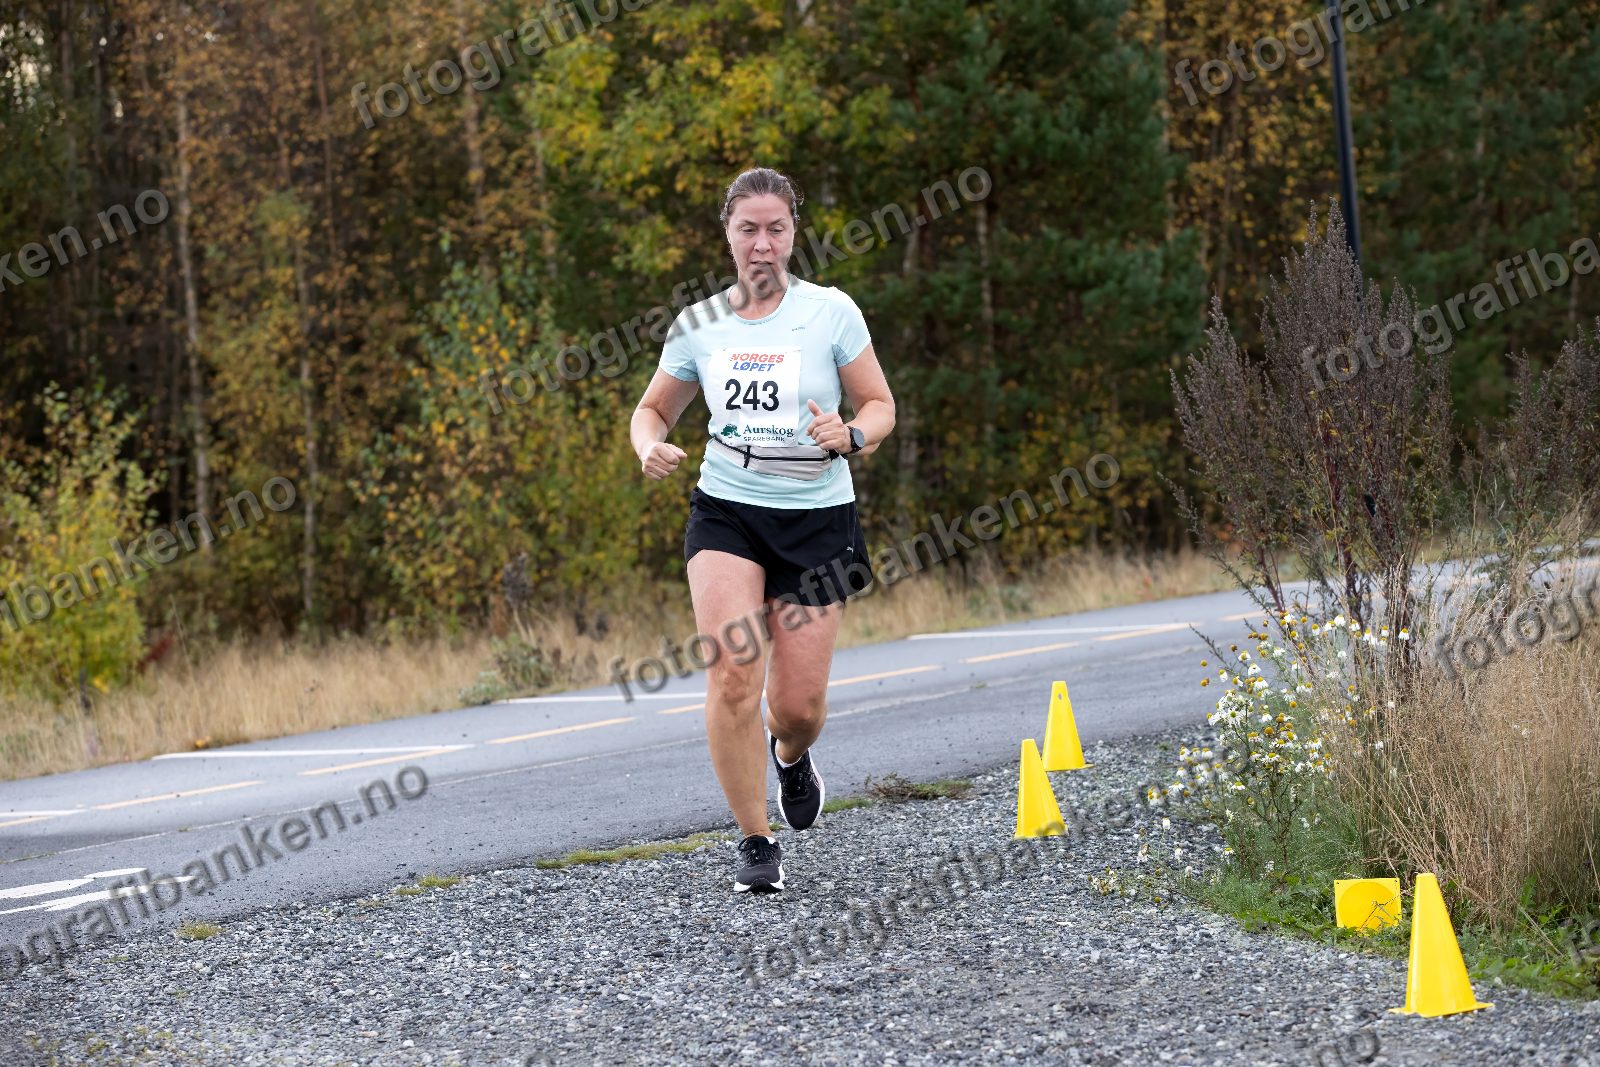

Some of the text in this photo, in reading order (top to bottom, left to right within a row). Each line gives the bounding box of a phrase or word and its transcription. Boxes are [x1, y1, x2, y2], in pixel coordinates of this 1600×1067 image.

[730, 353, 785, 363] NORGES
[733, 361, 775, 372] LØPET
[725, 378, 780, 412] 243
[743, 424, 794, 437] Aurskog
